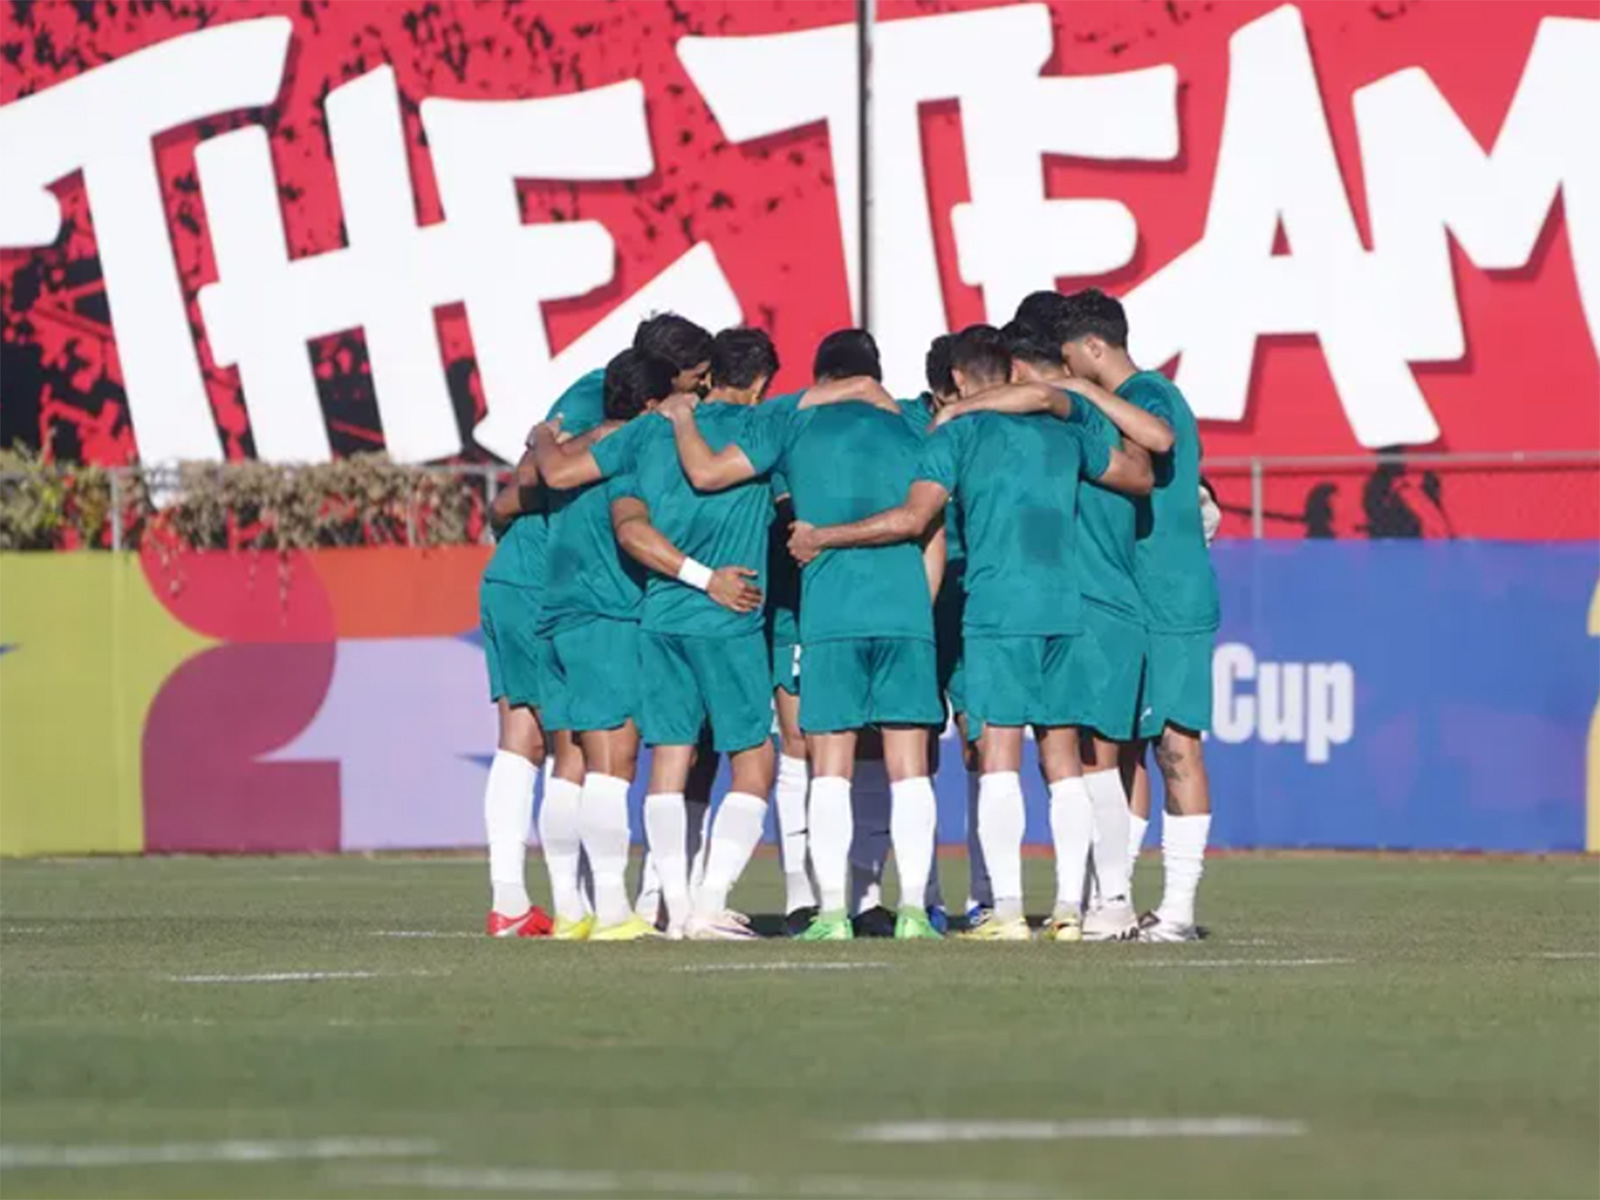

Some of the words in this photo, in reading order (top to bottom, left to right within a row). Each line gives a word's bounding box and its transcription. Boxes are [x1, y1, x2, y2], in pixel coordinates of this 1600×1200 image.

[0, 16, 743, 509] THE
[677, 2, 1600, 447] TEAM
[1211, 642, 1354, 763] Cup
